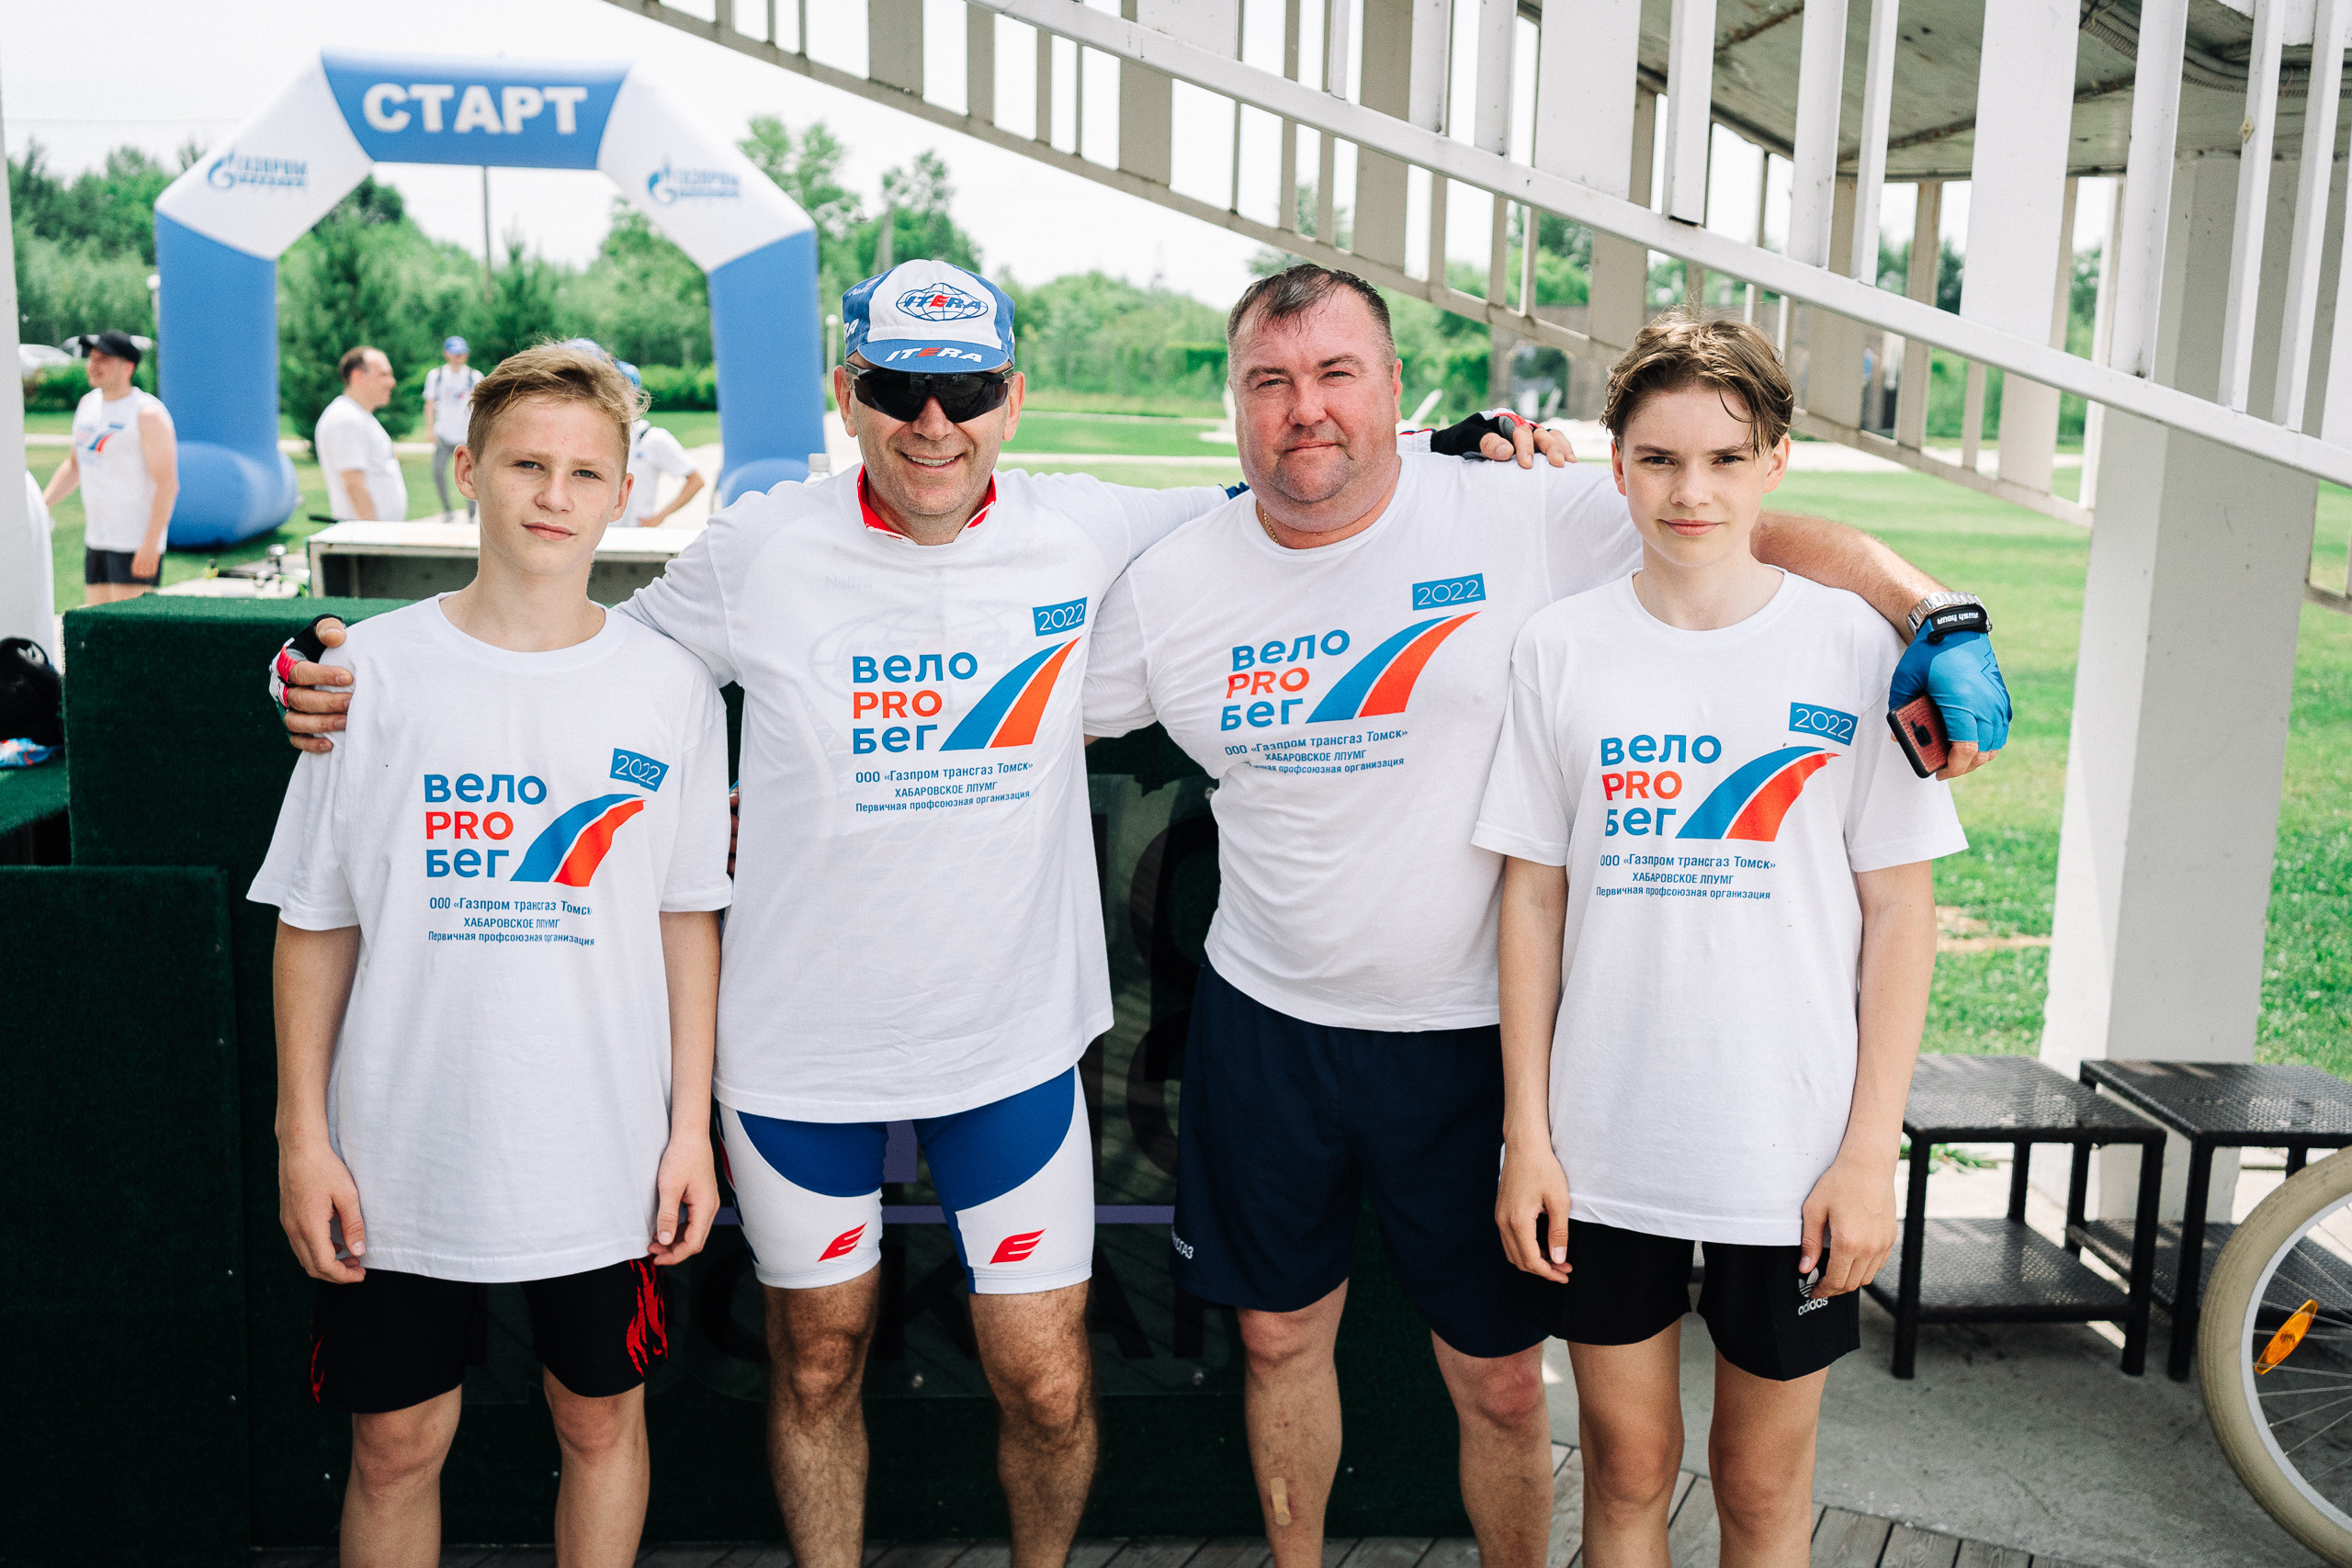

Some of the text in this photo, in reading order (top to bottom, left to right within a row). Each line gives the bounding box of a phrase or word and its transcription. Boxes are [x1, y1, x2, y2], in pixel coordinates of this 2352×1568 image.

[362, 82, 589, 135] СТАРТ
[904, 295, 981, 310] ITERA
[884, 347, 983, 363] ITERA
[1417, 580, 1481, 607] 2022
[1037, 604, 1085, 632] 2022
[1226, 667, 1310, 699] PRO
[854, 690, 942, 719] PRO
[1794, 707, 1853, 740] 2022
[1225, 730, 1408, 755] ООО «Газпром трансгаз Томск»
[1265, 750, 1366, 762] ХАБАРОВСКОЕ ЛПУМГ
[1278, 765, 1342, 775] профсоюзная
[1344, 757, 1404, 773] организация
[614, 753, 662, 786] 2022
[856, 762, 1033, 783] ООО «Газпром трансгаз Томск»
[895, 782, 998, 797] ХАБАРОВСКОЕ ЛПУМГ
[1602, 771, 1682, 800] PRO
[856, 791, 1030, 813] Первичная профсоюзная организация
[425, 811, 514, 840] PRO
[1600, 853, 1776, 869] ООО «Газпром трансгаз Томск»
[1633, 873, 1734, 885] ХАБАРОВСКОЕ ЛПУМГ
[1597, 886, 1770, 900] Первичная профсоюзная организация
[430, 897, 450, 909] ООО
[454, 897, 510, 911] «Газпром
[514, 901, 556, 913] трансгаз
[464, 918, 560, 929] ХАБАРОВСКОЕ ЛПУМГ
[428, 931, 594, 946] Первичная профсоюзная организация
[1798, 1296, 1828, 1316] adidas
